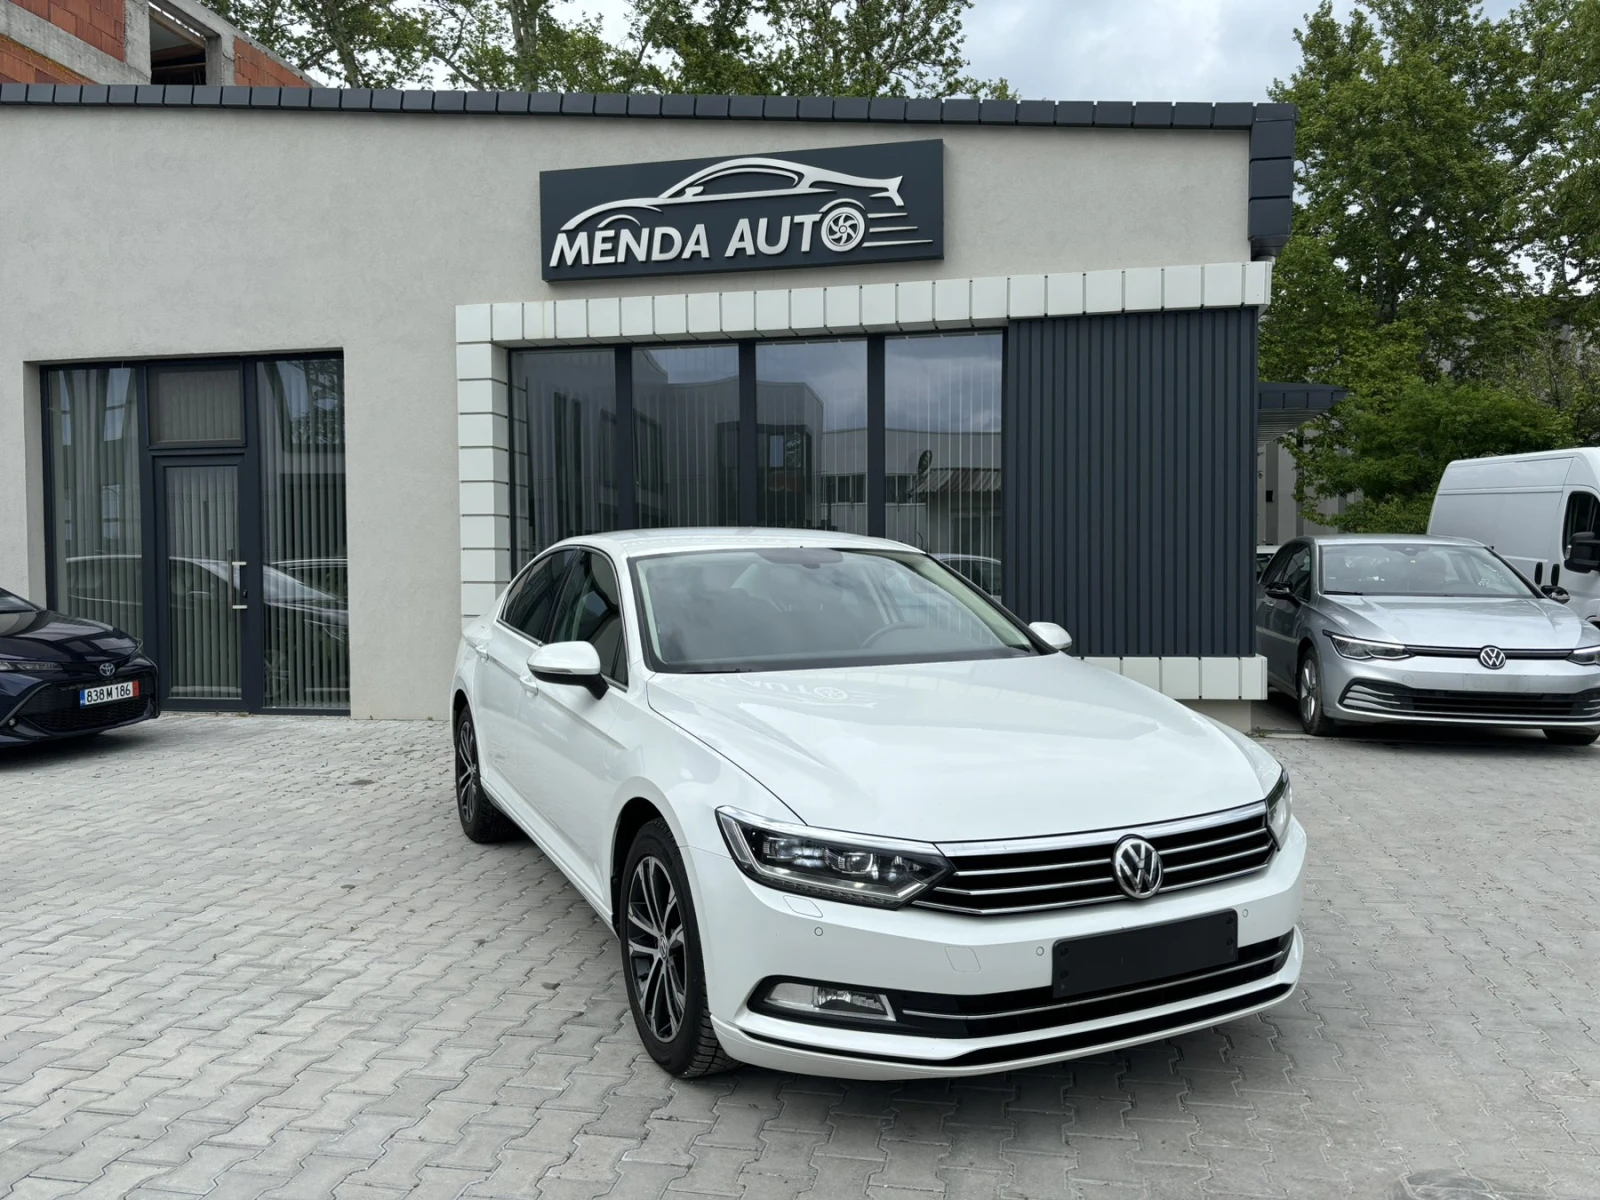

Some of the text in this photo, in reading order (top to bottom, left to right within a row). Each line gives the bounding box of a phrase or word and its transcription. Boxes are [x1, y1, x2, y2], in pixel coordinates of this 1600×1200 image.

[549, 223, 711, 267] MENDA
[87, 683, 131, 703] 838 M 186
